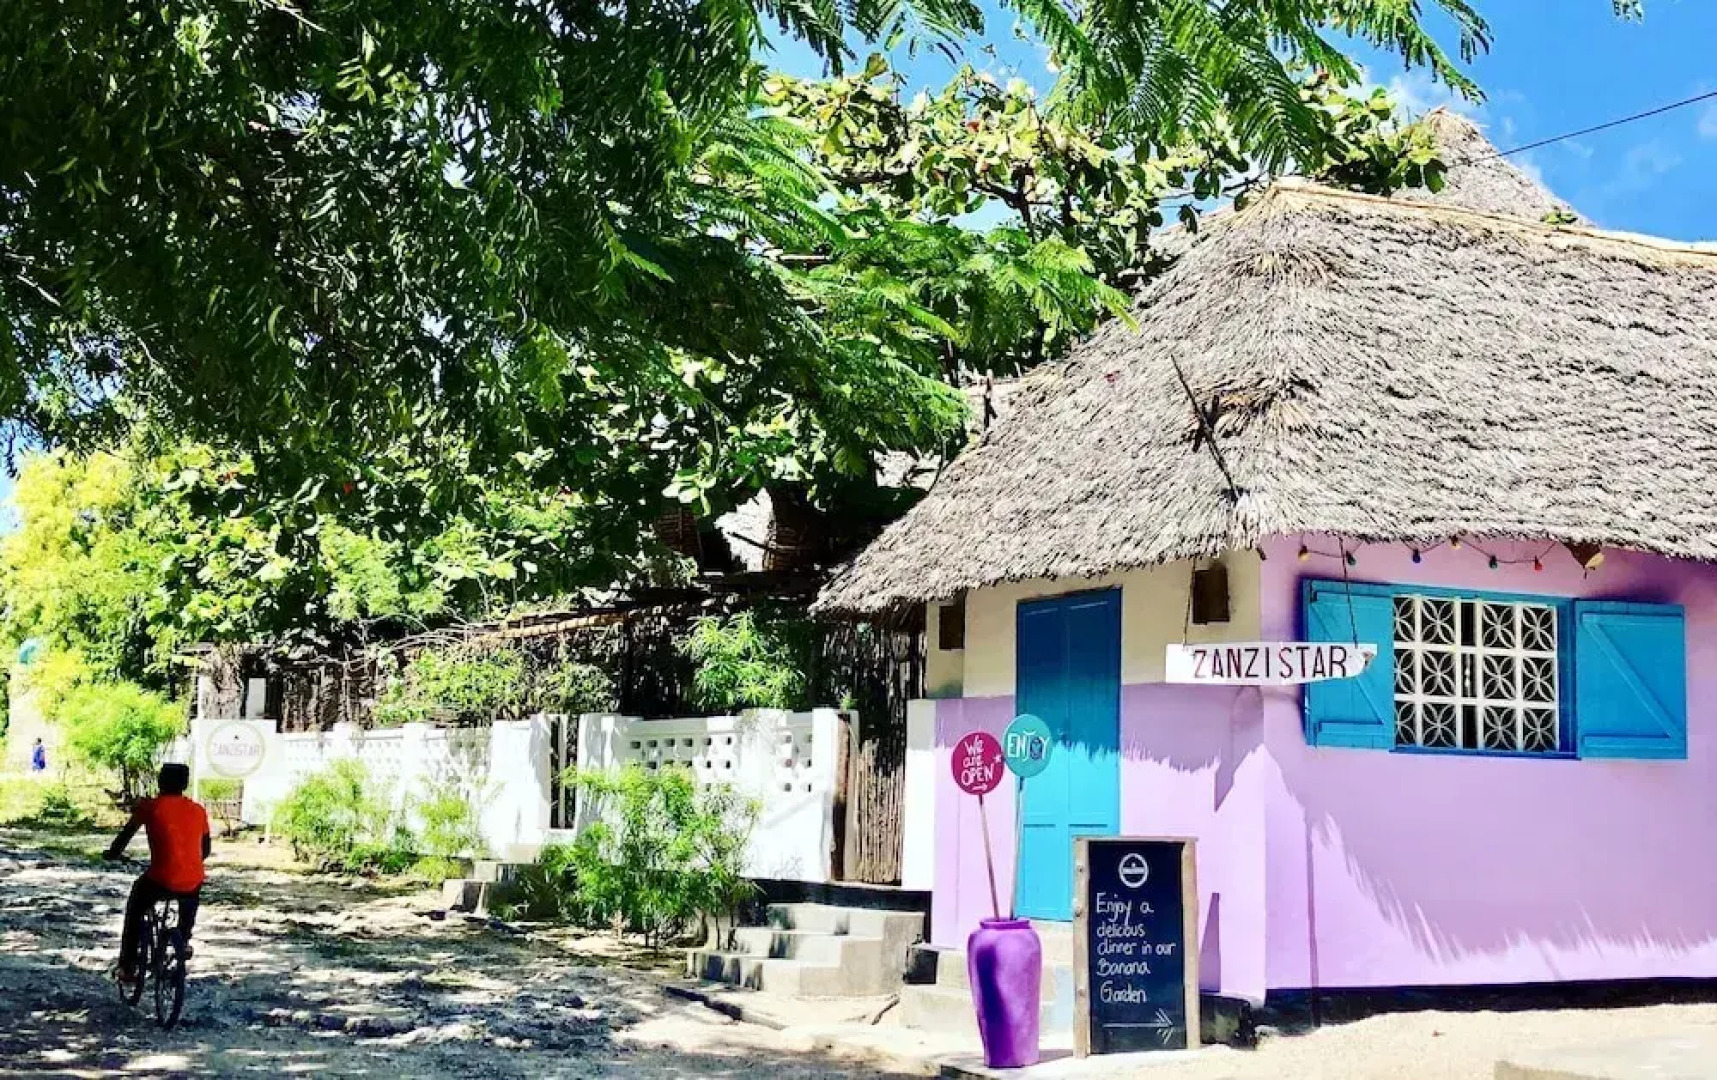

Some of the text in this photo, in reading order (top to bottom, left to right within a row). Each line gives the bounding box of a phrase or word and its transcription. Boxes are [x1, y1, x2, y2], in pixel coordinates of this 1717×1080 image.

[1006, 730, 1050, 762] ENJOY
[961, 763, 995, 786] OPEN
[1096, 892, 1154, 926] Enjoy a
[1097, 939, 1176, 956] dinner in our
[1096, 957, 1151, 976] Banana
[1100, 980, 1146, 1004] Garden
